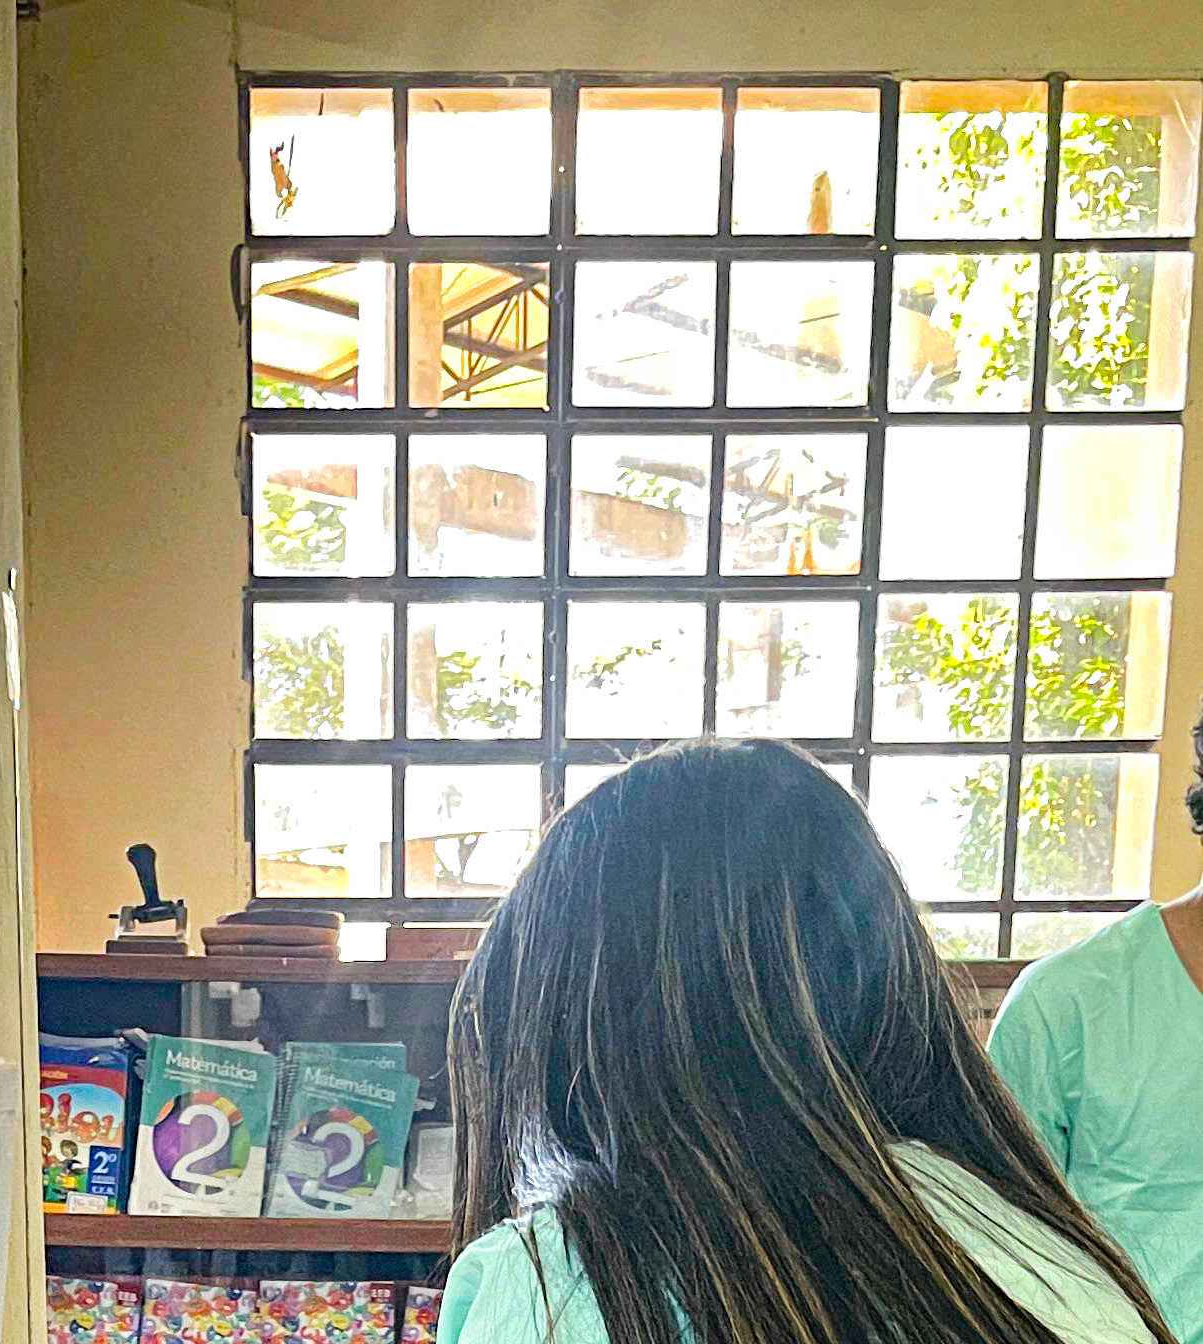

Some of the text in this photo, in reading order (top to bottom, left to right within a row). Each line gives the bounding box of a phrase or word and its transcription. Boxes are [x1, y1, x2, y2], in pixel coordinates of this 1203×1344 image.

[166, 1049, 258, 1082] Matemática
[304, 1066, 396, 1102] Matemática
[170, 1103, 232, 1189] 2
